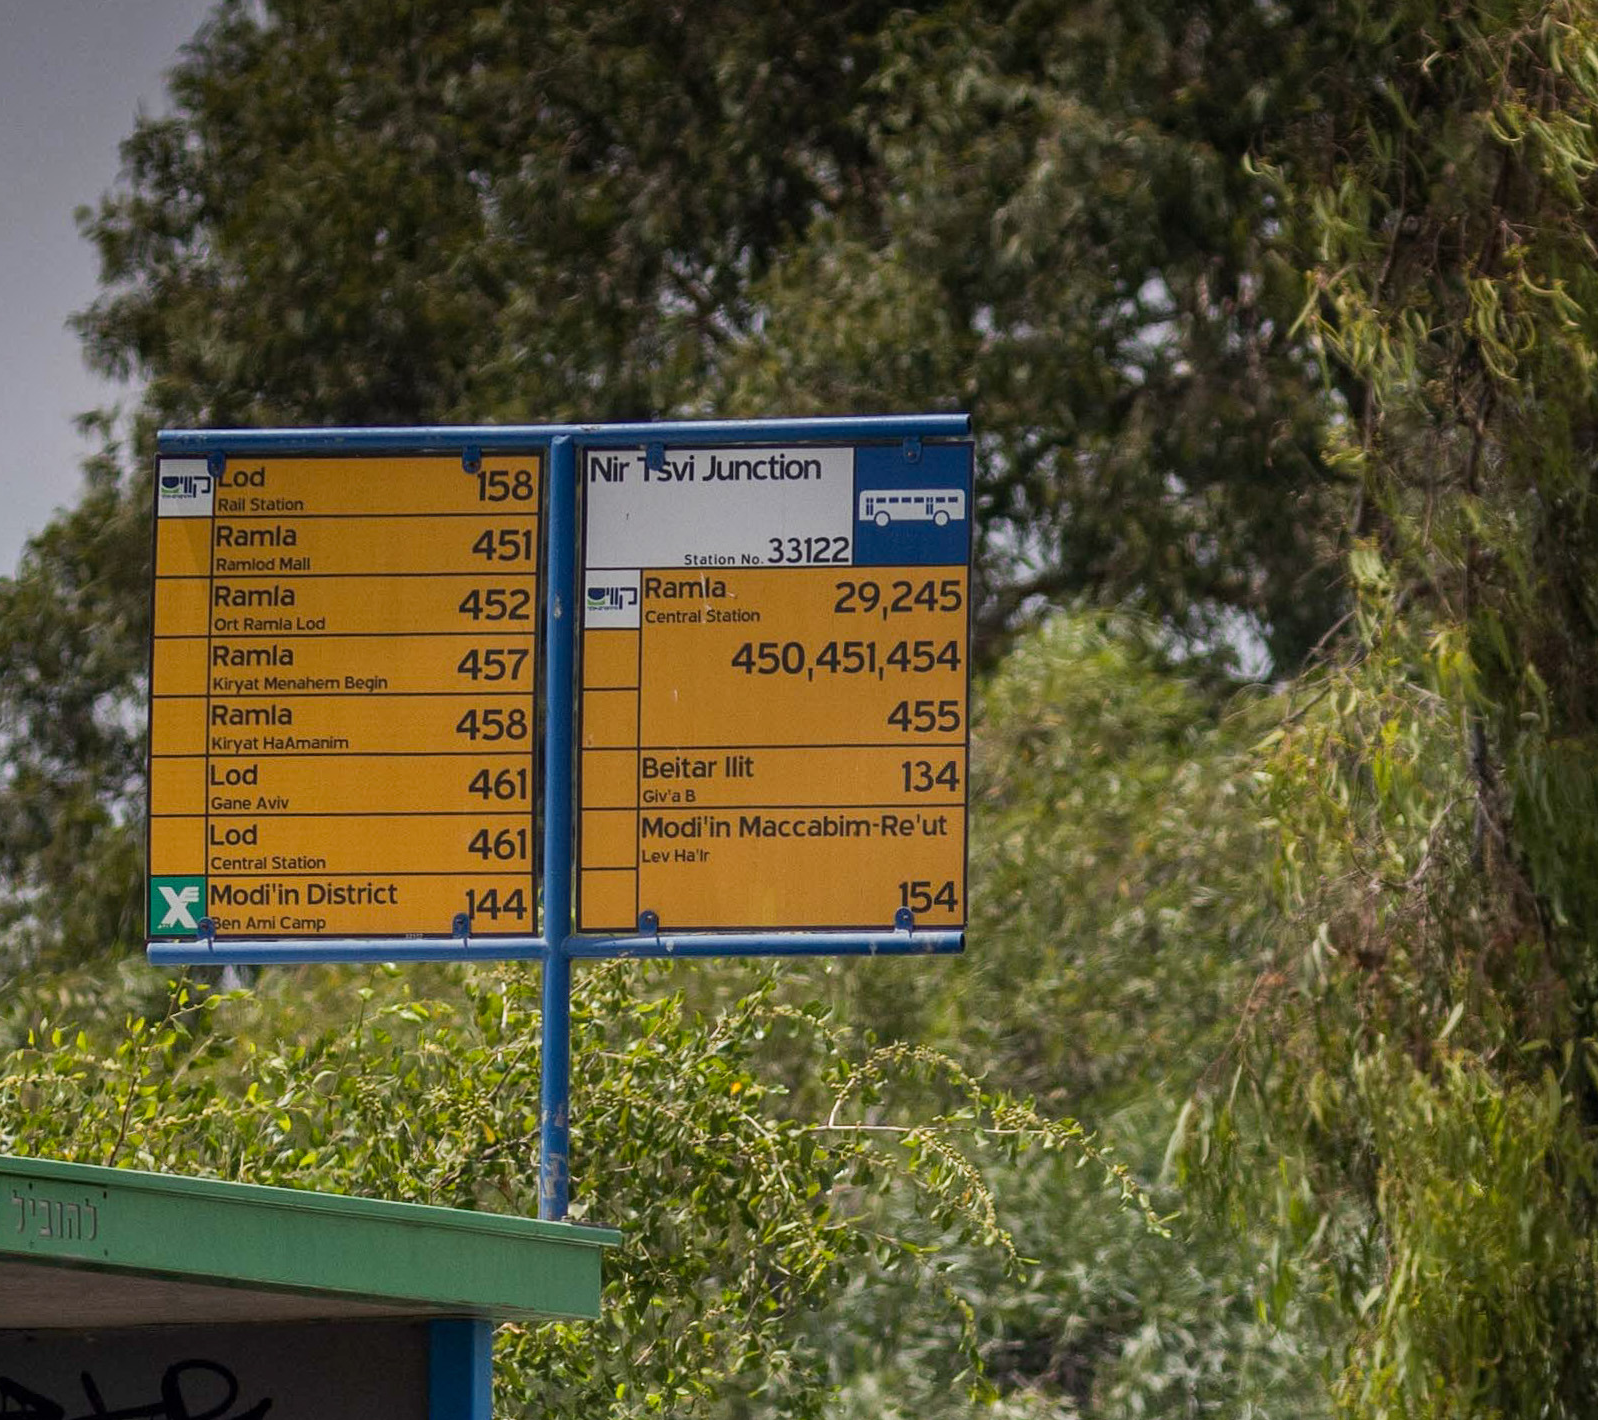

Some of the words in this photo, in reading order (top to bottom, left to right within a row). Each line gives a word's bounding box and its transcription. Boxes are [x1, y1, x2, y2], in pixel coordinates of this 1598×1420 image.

[217, 466, 265, 488] Lod
[477, 470, 533, 501] 158
[590, 456, 630, 484] Nir
[703, 453, 821, 482] Junction
[218, 498, 243, 511] Rail
[247, 498, 303, 511] Station
[216, 525, 297, 547] Ramla
[472, 530, 533, 561] 451
[684, 554, 735, 566] Station
[740, 553, 763, 566] No.
[768, 536, 849, 564] 33122
[216, 558, 274, 571] Ramlod
[278, 557, 310, 570] Mall
[214, 586, 295, 607] Ramla
[459, 589, 530, 621] 452
[645, 578, 726, 599] Ramla
[834, 580, 962, 621] 29,245
[214, 618, 240, 630] Ort
[244, 617, 292, 630] Ramla
[297, 617, 326, 630] Lod
[646, 610, 701, 623] Central
[706, 609, 760, 623] Station
[212, 645, 293, 667] Ramla
[457, 649, 530, 681] 457
[731, 640, 961, 682] 450,451,454
[213, 676, 258, 693] Kiryat
[264, 676, 340, 690] Menahem
[345, 676, 387, 691] Begin
[211, 704, 292, 726] Ramla
[456, 709, 528, 741] 458
[887, 700, 960, 733] 455
[211, 736, 258, 753] Kiryat
[263, 736, 349, 750] HaAmanim
[210, 765, 258, 786] Lod
[468, 768, 527, 801] 461
[642, 756, 717, 779] Beitar
[725, 755, 754, 778] Ilit
[902, 760, 960, 793] 134
[211, 797, 252, 810] Gane
[256, 797, 289, 810] Aviv
[643, 789, 681, 803] Giv'a
[685, 789, 695, 802] B
[642, 816, 730, 838] Modi'in
[739, 814, 947, 838] Maccabim-Re'ut
[210, 824, 258, 846] Lod
[468, 829, 527, 861] 461
[642, 850, 670, 863] Lev
[211, 856, 266, 870] Central
[272, 856, 326, 869] Station
[210, 884, 300, 907] Modi'in
[308, 883, 398, 905] District
[466, 888, 527, 921] 144
[898, 881, 958, 913] 154
[212, 917, 241, 930] Ben
[245, 916, 275, 930] Ami
[280, 916, 326, 932] Camp
[12, 1189, 97, 1241] להוביל
